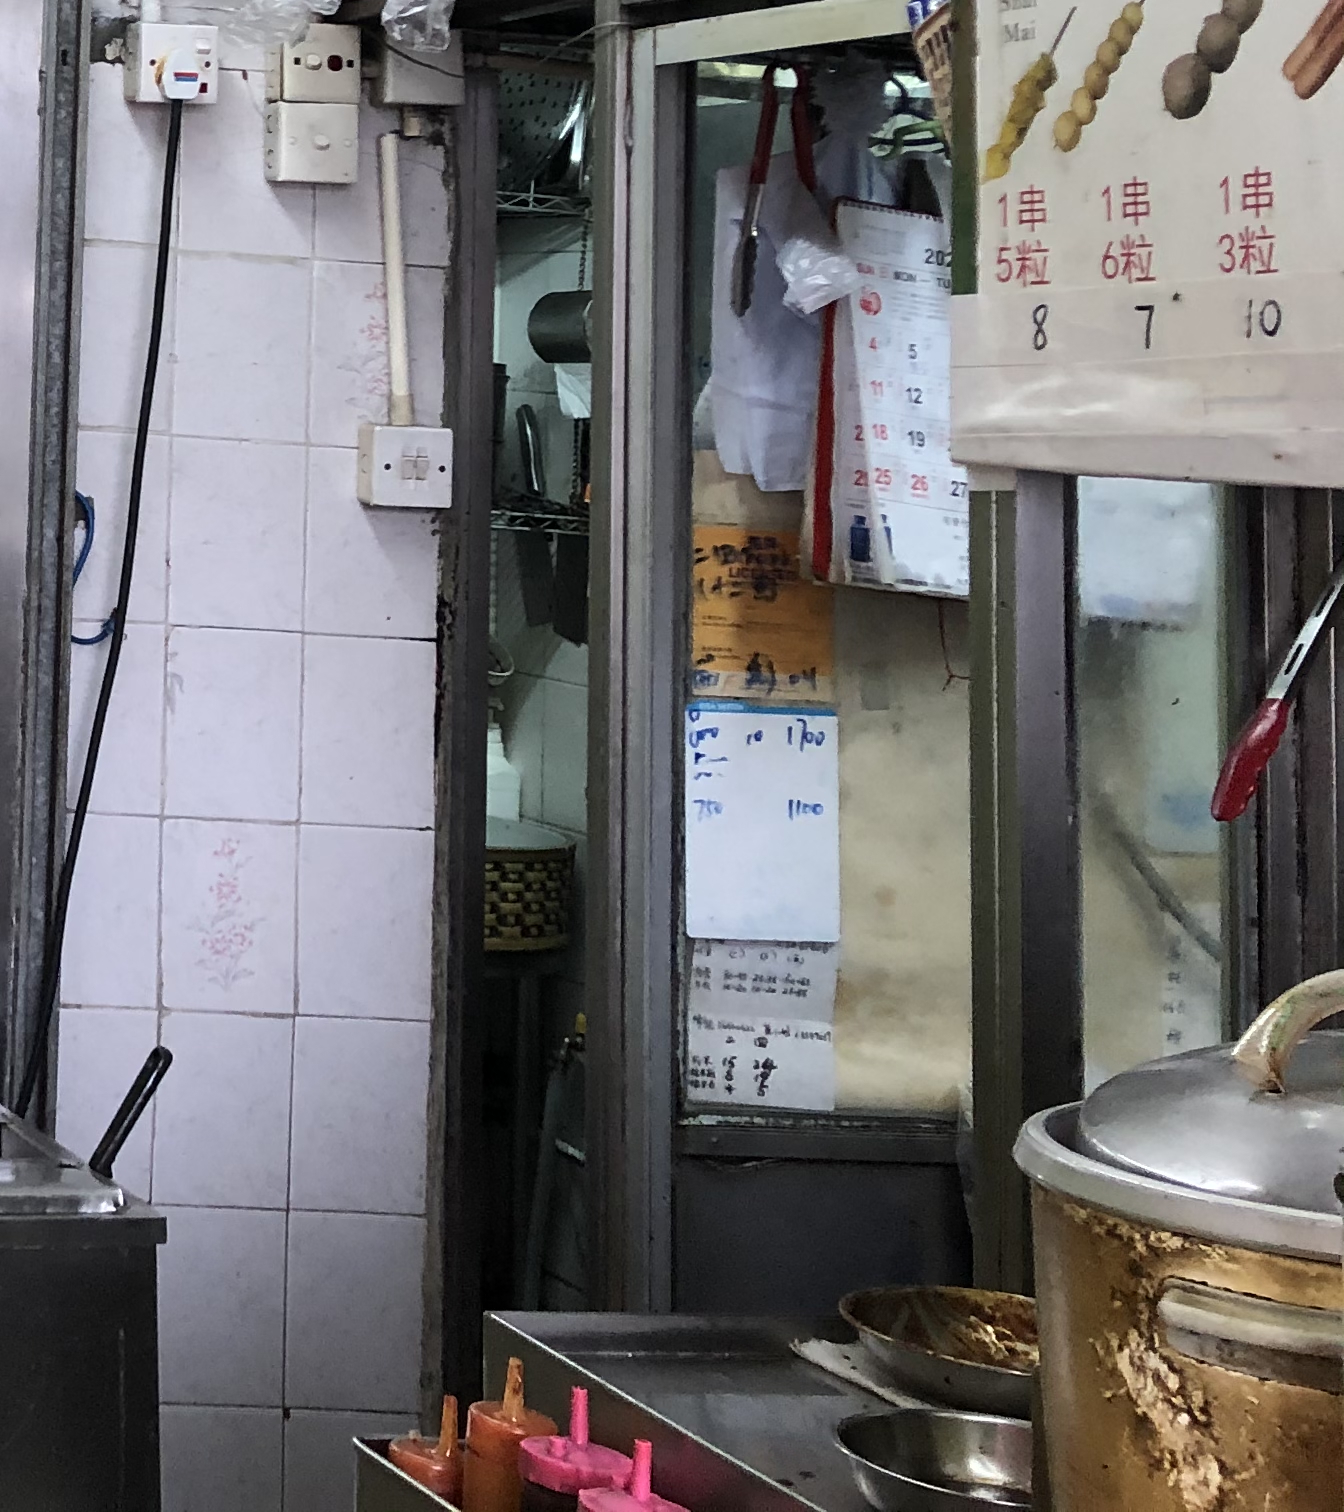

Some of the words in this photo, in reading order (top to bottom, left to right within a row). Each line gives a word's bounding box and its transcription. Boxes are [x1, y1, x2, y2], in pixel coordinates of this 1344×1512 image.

[1003, 20, 1036, 43] Mai
[1101, 175, 1151, 226] 1串
[1219, 165, 1274, 219] 1串
[997, 184, 1048, 232] 1串
[924, 248, 952, 267] 202
[1101, 233, 1157, 284] 6粒
[1218, 224, 1279, 275] 3粒
[996, 239, 1051, 288] 5粒
[937, 277, 952, 289] TU
[1032, 303, 1049, 351] 8
[1134, 304, 1156, 350] 7
[1245, 299, 1282, 339] 10
[868, 337, 878, 352] 4
[908, 344, 918, 360] 5
[869, 380, 884, 397] 11
[905, 388, 923, 404] 12
[872, 424, 889, 441] 18
[907, 430, 926, 447] 19
[874, 467, 892, 486] 25
[911, 474, 929, 492] 26
[951, 480, 968, 497] 27
[787, 718, 826, 752] 1700
[788, 799, 824, 820] 1100
